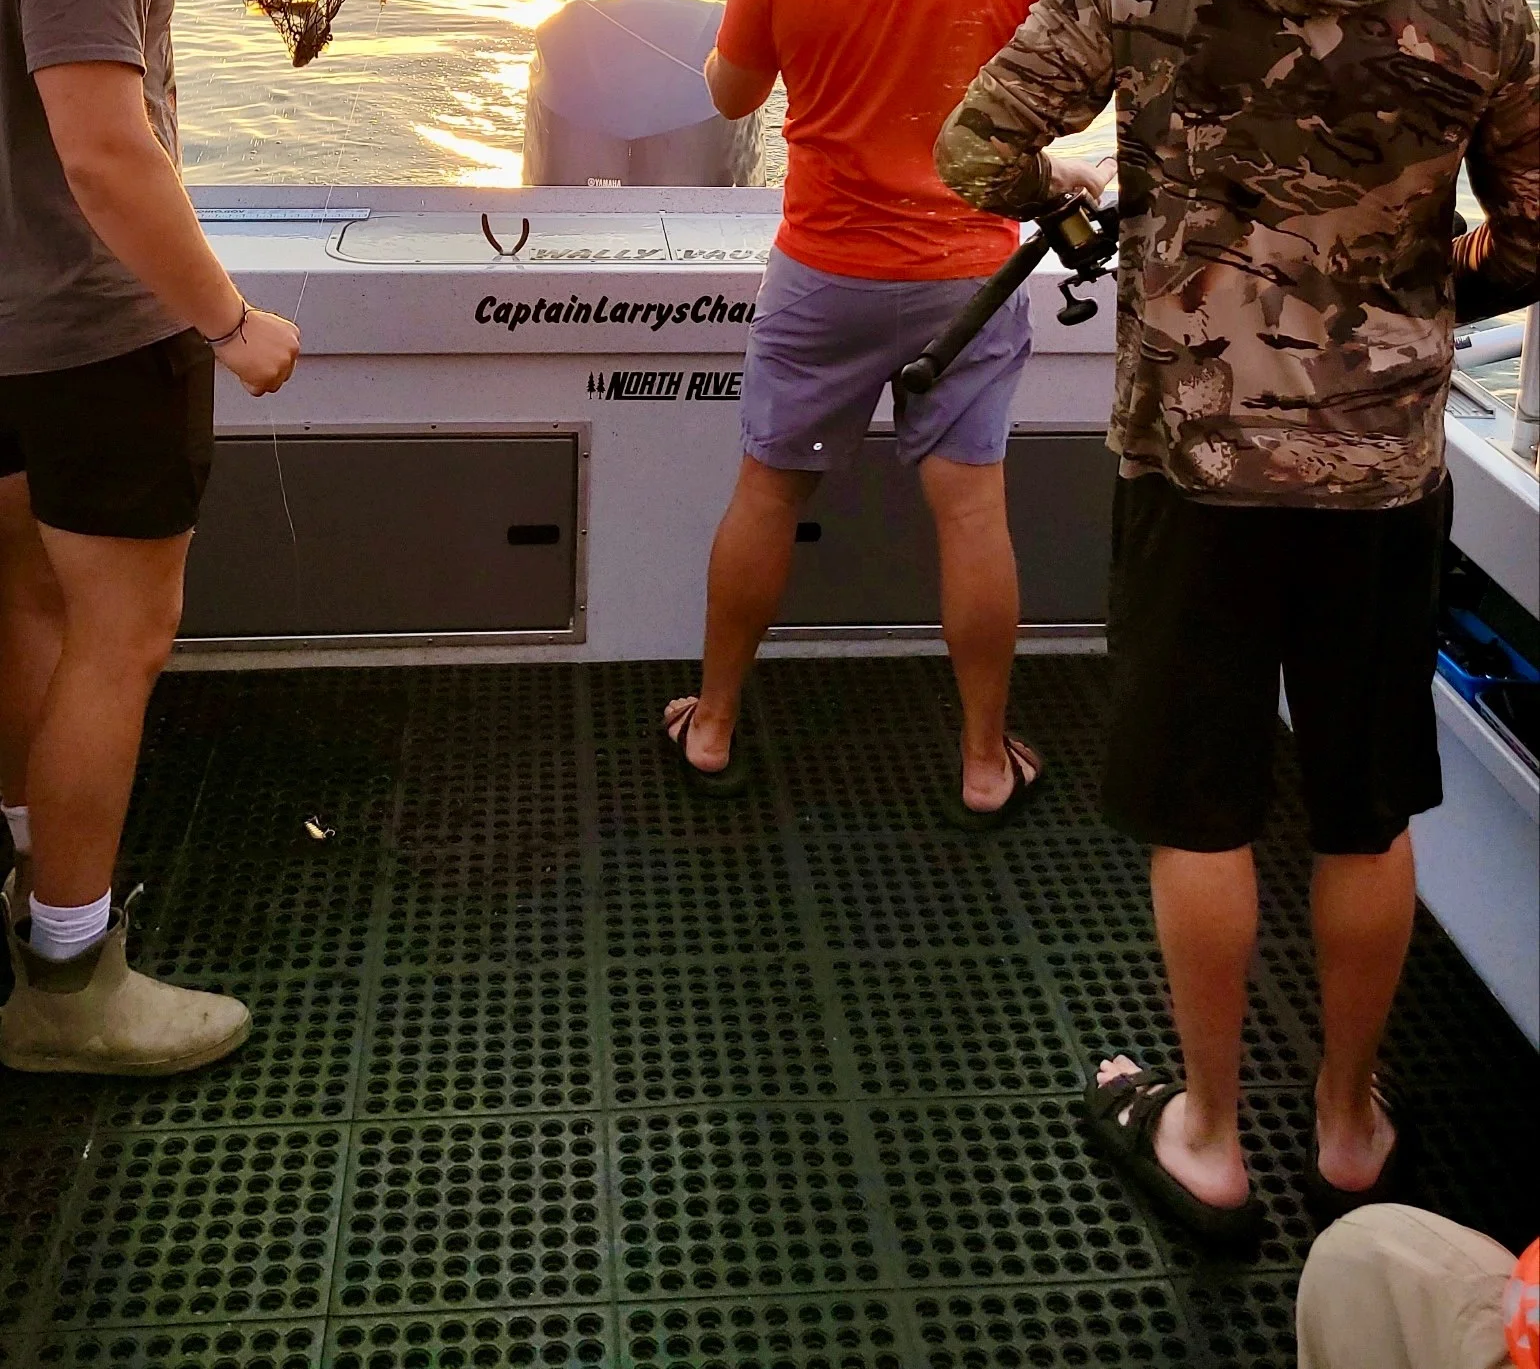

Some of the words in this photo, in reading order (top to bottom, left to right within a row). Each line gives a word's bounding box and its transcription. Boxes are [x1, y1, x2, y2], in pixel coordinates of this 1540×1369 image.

[595, 178, 622, 187] YAMAHA
[535, 248, 663, 259] WALLY
[605, 371, 684, 401] NORTH
[685, 371, 744, 401] RIVE
